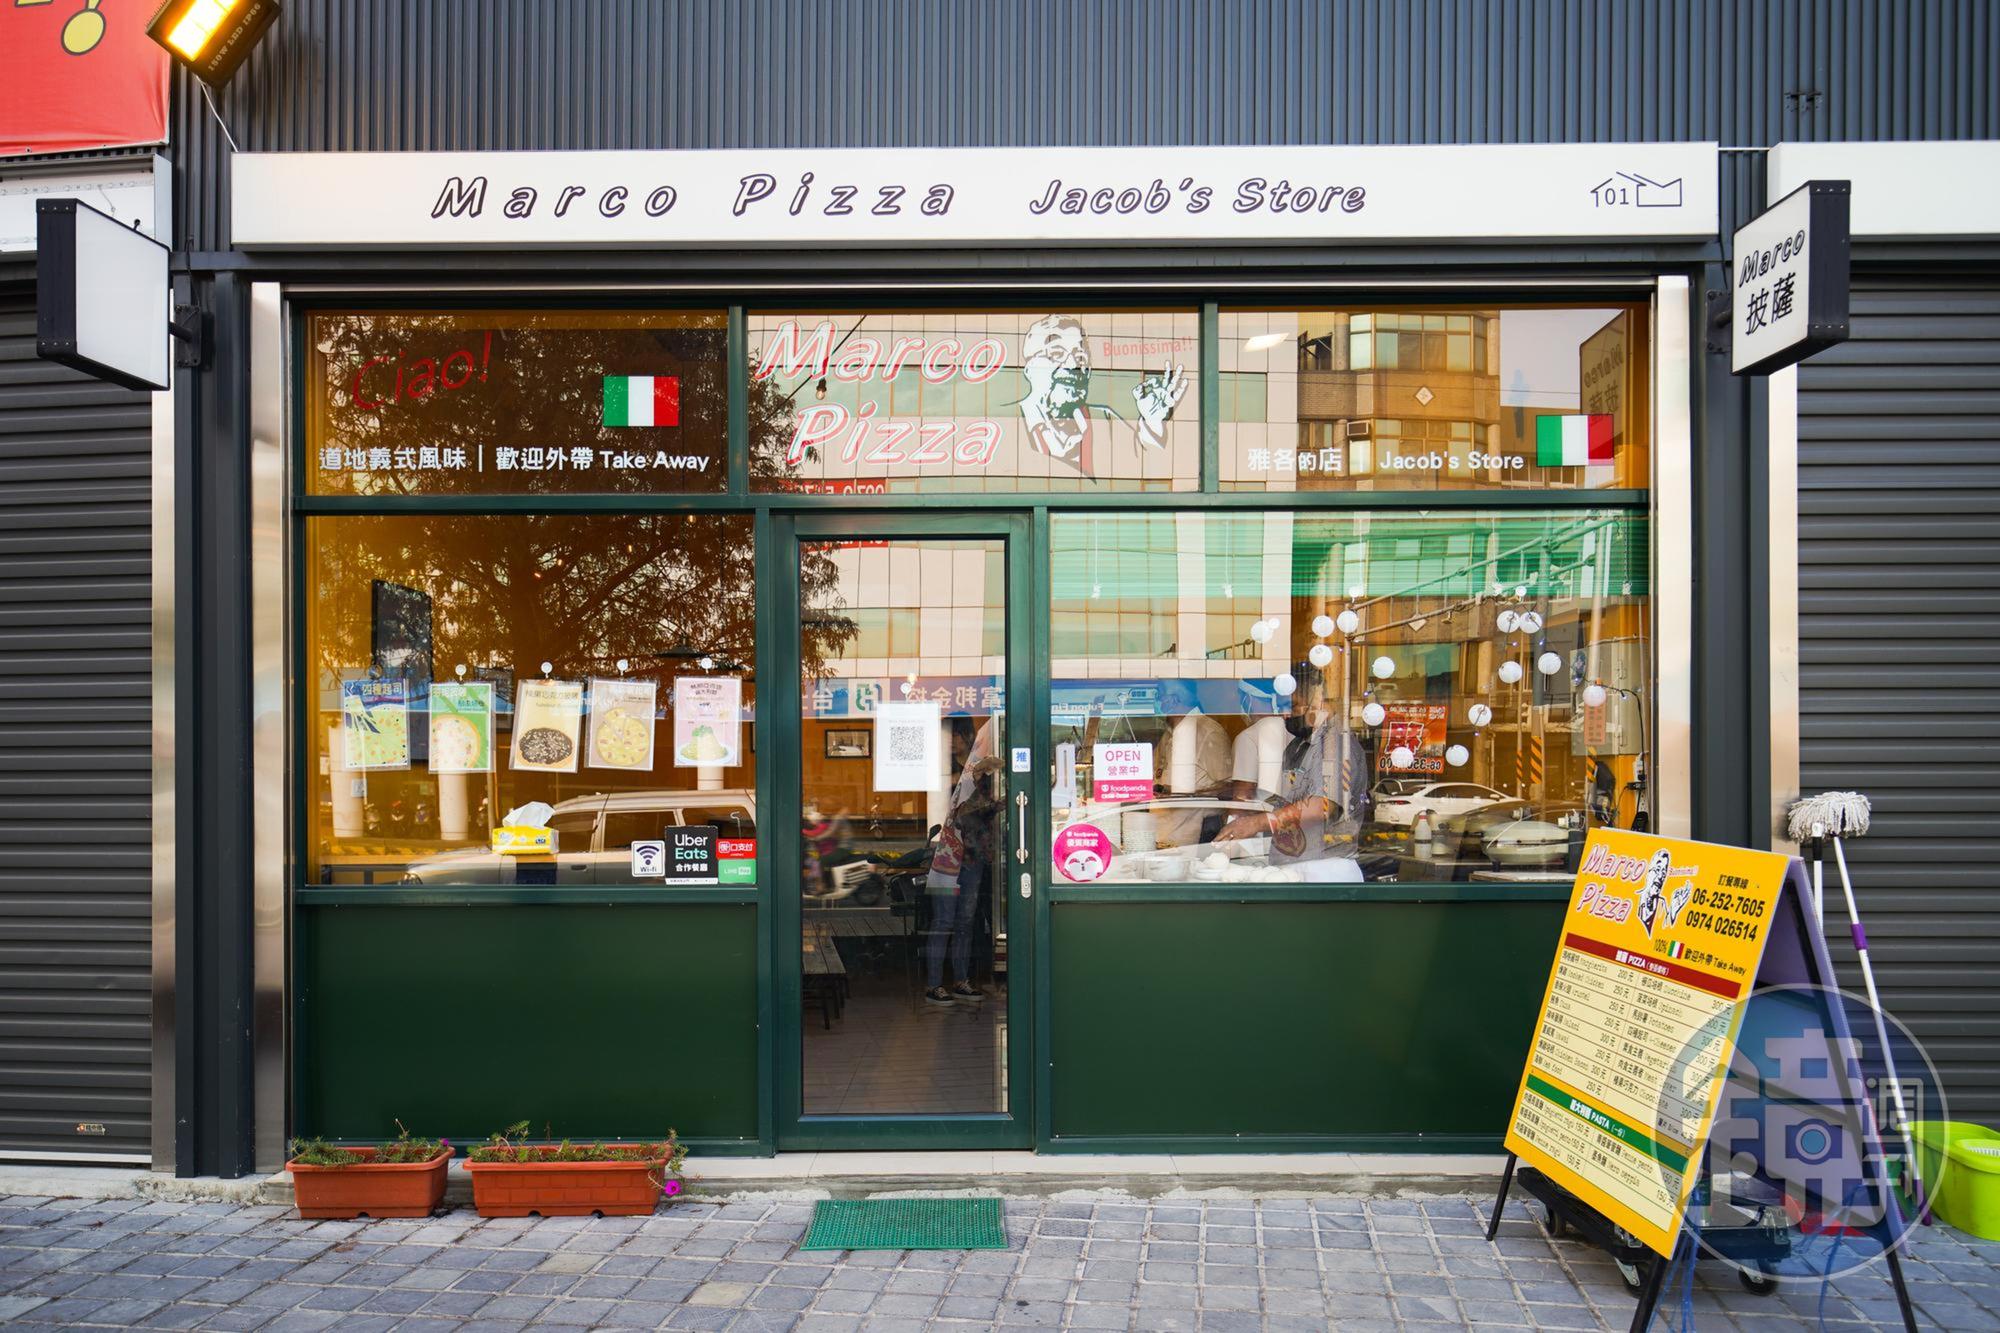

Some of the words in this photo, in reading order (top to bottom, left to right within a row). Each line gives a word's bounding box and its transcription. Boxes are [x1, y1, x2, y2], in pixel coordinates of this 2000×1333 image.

[227, 26, 244, 46] LED
[431, 176, 677, 218] Marco
[733, 172, 955, 217] Pizza
[1029, 178, 1213, 215] Jacob's
[1233, 177, 1366, 213] Store
[1738, 229, 1806, 289] Marco
[1745, 272, 1797, 336] 披薩
[755, 319, 1009, 383] Marco
[1102, 336, 1194, 358] Buonissima!!
[351, 331, 493, 411] Ciao!
[786, 400, 1005, 466] Pizza
[319, 447, 467, 471] 道地義式風味
[496, 446, 594, 471] 歡迎外帶
[600, 450, 646, 470] Take
[654, 450, 709, 472] Away
[1247, 448, 1342, 473] 雅各的店
[1380, 451, 1460, 469] Jacob's
[1467, 451, 1524, 469] Store
[1016, 751, 1028, 763] 推
[1105, 750, 1141, 762] OPEN
[675, 834, 708, 847] Uber
[675, 848, 708, 860] Eats
[1582, 844, 1647, 882] Marco
[1577, 883, 1632, 923] Pizza
[1692, 887, 1766, 918] 06-252-7605
[1686, 910, 1714, 931] 0974
[1714, 916, 1759, 942] 026514
[1713, 957, 1728, 970] Take
[1728, 962, 1747, 976] Away
